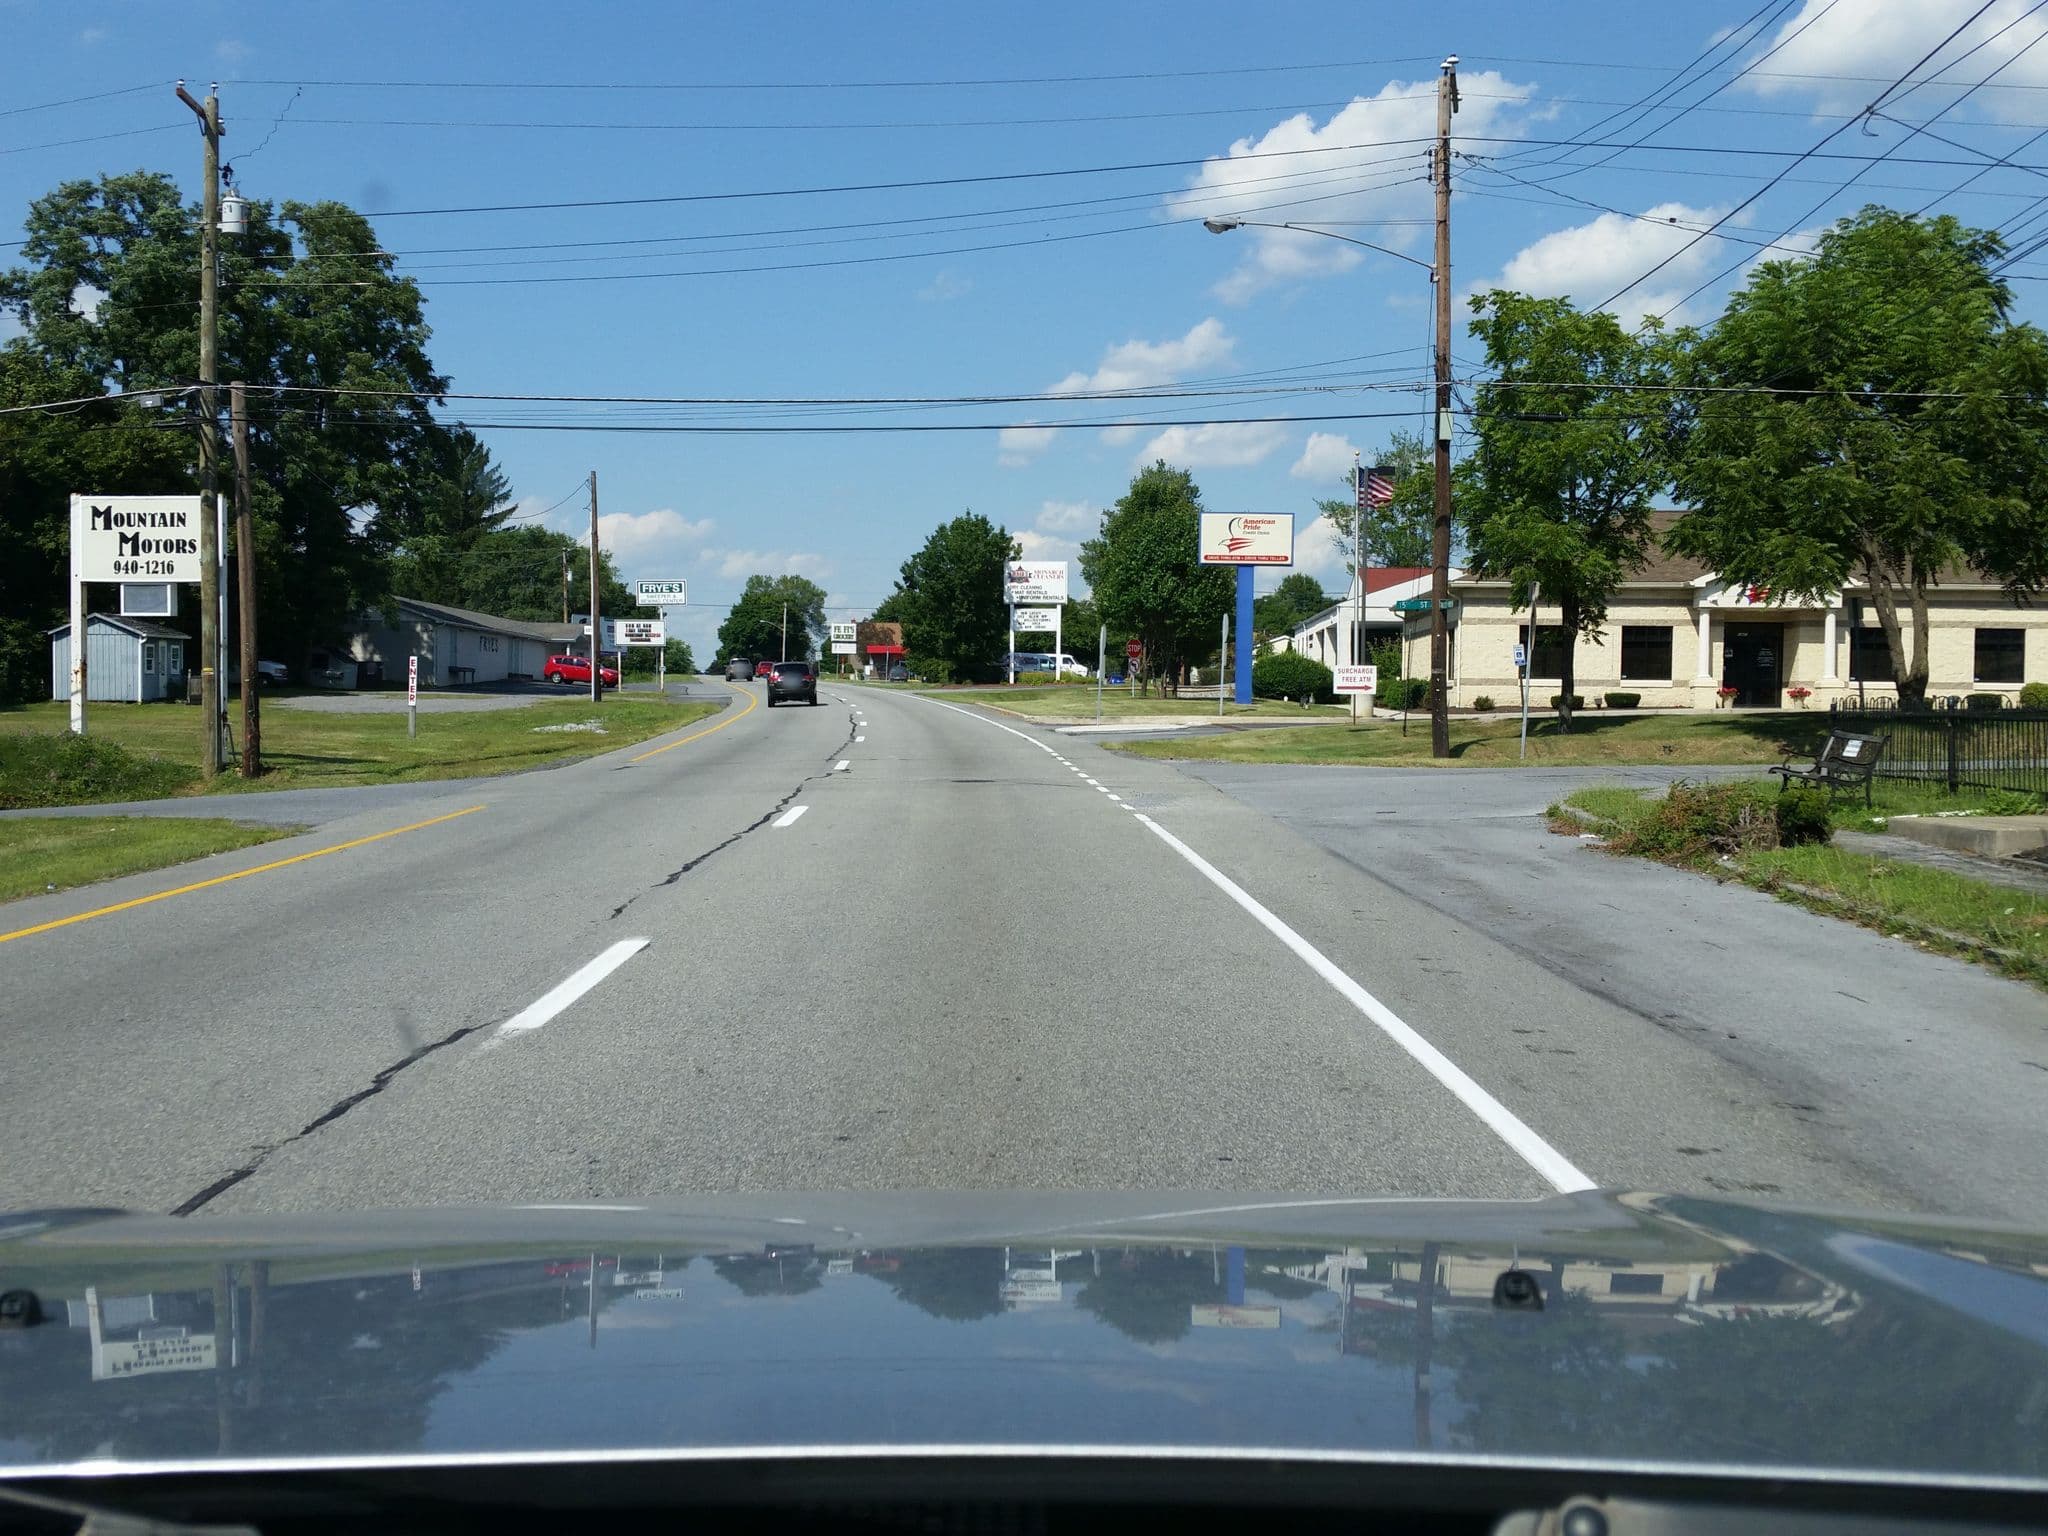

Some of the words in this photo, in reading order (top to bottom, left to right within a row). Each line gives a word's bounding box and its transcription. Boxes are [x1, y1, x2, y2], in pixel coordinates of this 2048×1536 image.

[91, 505, 186, 531] MOUNTAIN
[118, 531, 197, 557] MOTORS
[113, 560, 174, 575] 940-1216
[642, 584, 681, 593] FRYE'S
[1128, 644, 1141, 652] STOP
